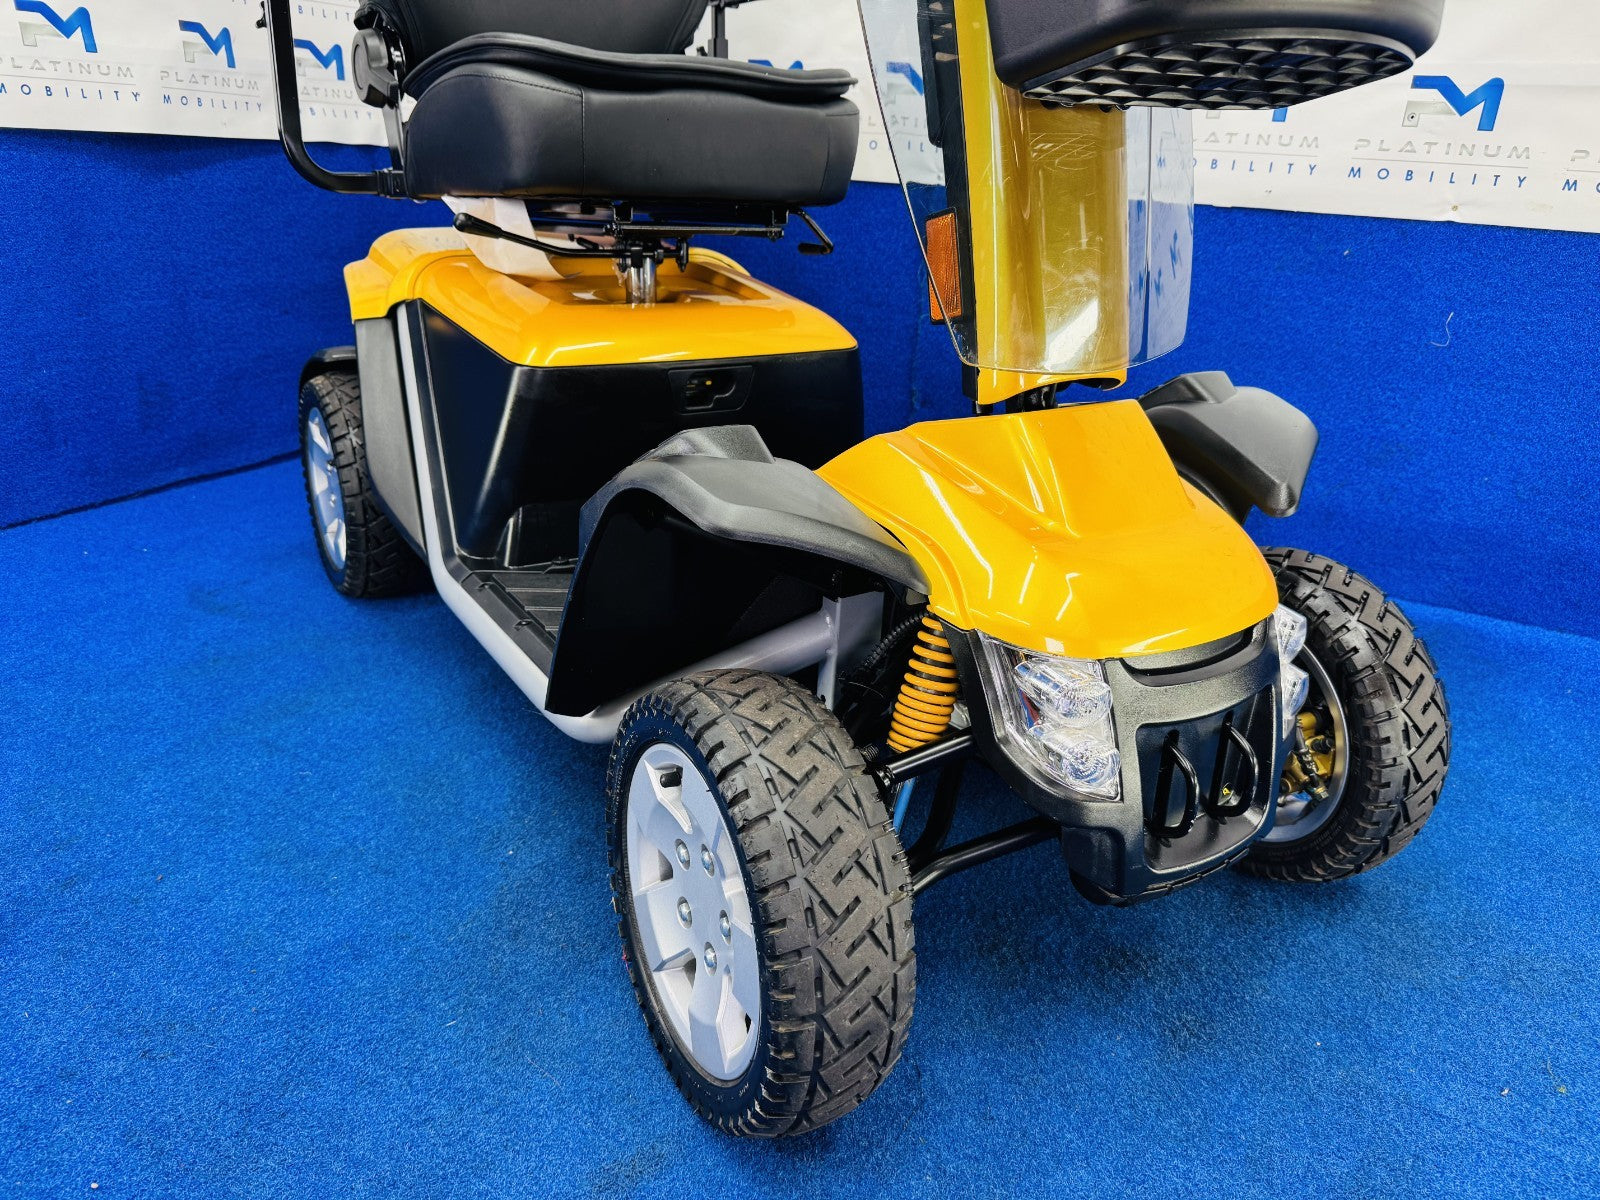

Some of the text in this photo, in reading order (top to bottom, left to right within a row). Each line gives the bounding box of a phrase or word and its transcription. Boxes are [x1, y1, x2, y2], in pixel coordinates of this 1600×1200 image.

[0, 57, 134, 78] LATINUM
[160, 70, 259, 90] PLATINUM
[163, 94, 262, 111] MOBILITY
[1353, 138, 1530, 160] PLATINUM
[1347, 166, 1527, 188] MOBILITY
